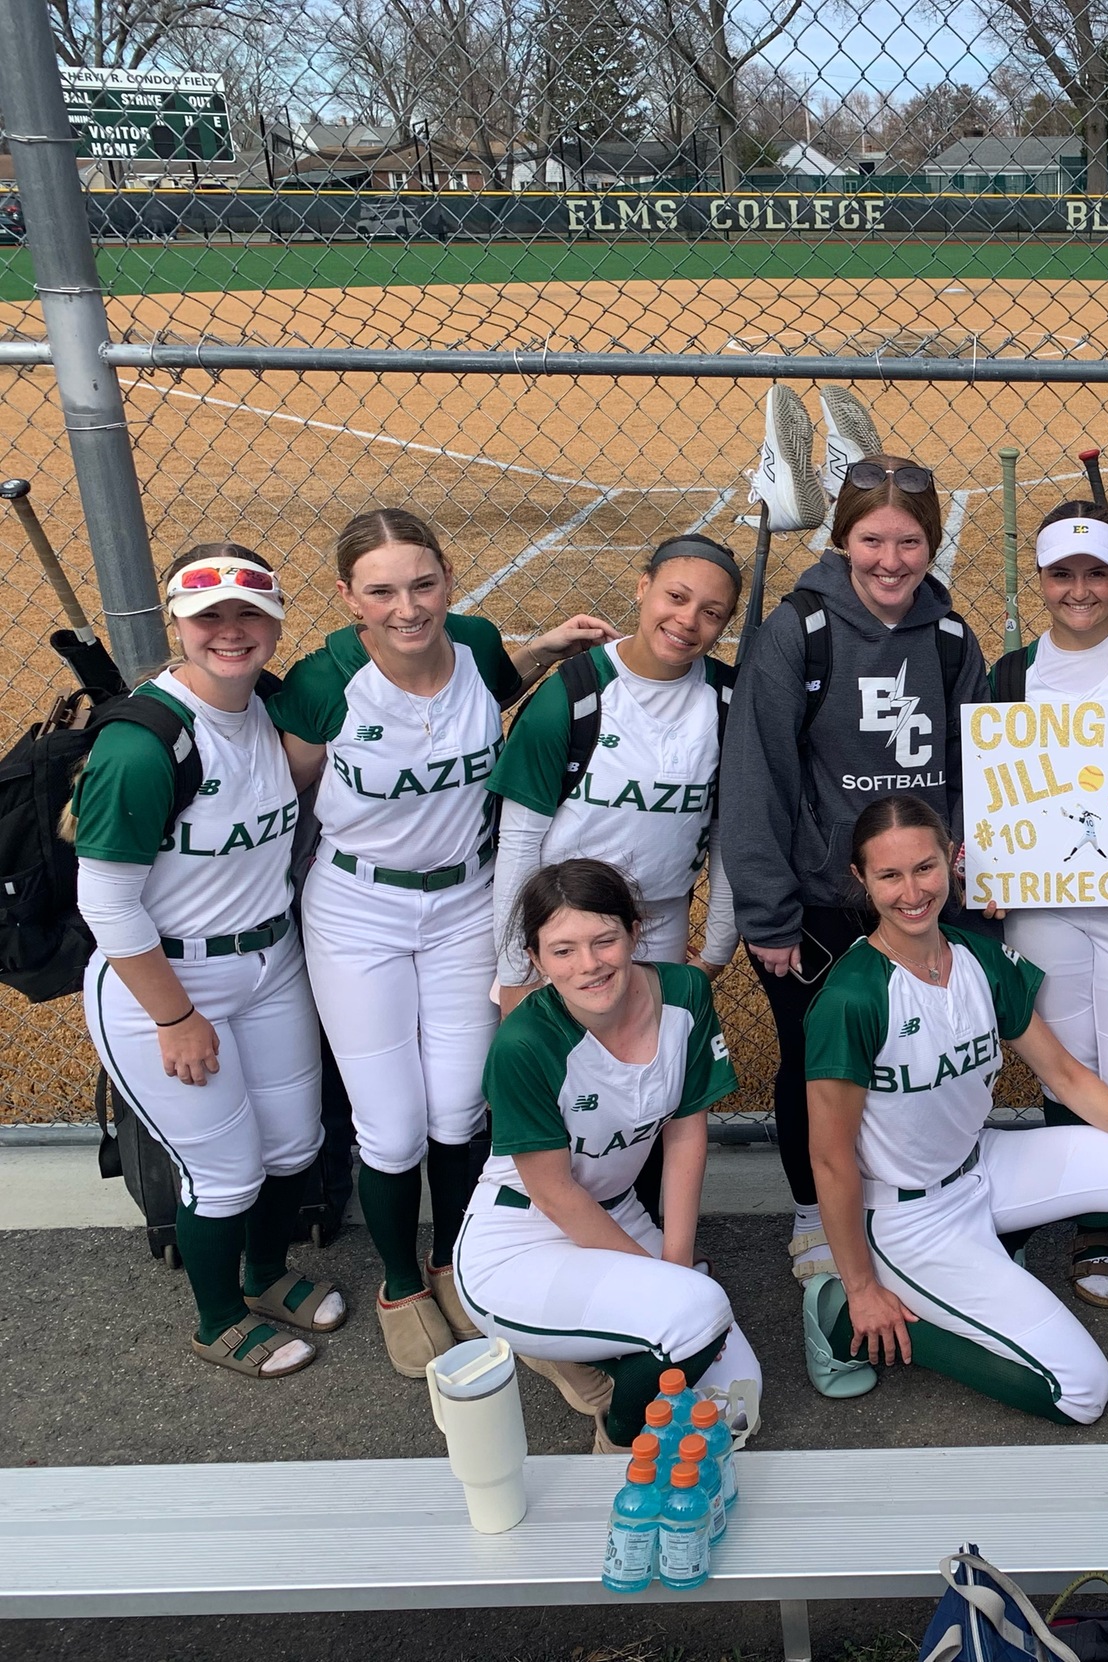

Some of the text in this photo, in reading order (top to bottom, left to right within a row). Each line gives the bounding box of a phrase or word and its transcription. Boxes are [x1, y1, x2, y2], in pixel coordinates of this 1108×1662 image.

[111, 74, 123, 83] R.
[127, 74, 181, 86] CONDON
[184, 76, 217, 87] FIELD
[121, 93, 163, 107] STRIKE
[188, 95, 212, 109] OUT
[184, 115, 193, 127] H
[213, 116, 222, 128] E
[88, 125, 152, 141] VISITOR
[91, 142, 139, 157] HOME
[567, 199, 886, 231] ELMS COLLEGE
[858, 677, 933, 768] EC
[841, 770, 947, 791] SOFTBALL
[983, 752, 1074, 815] JILL
[973, 818, 1038, 855] #10
